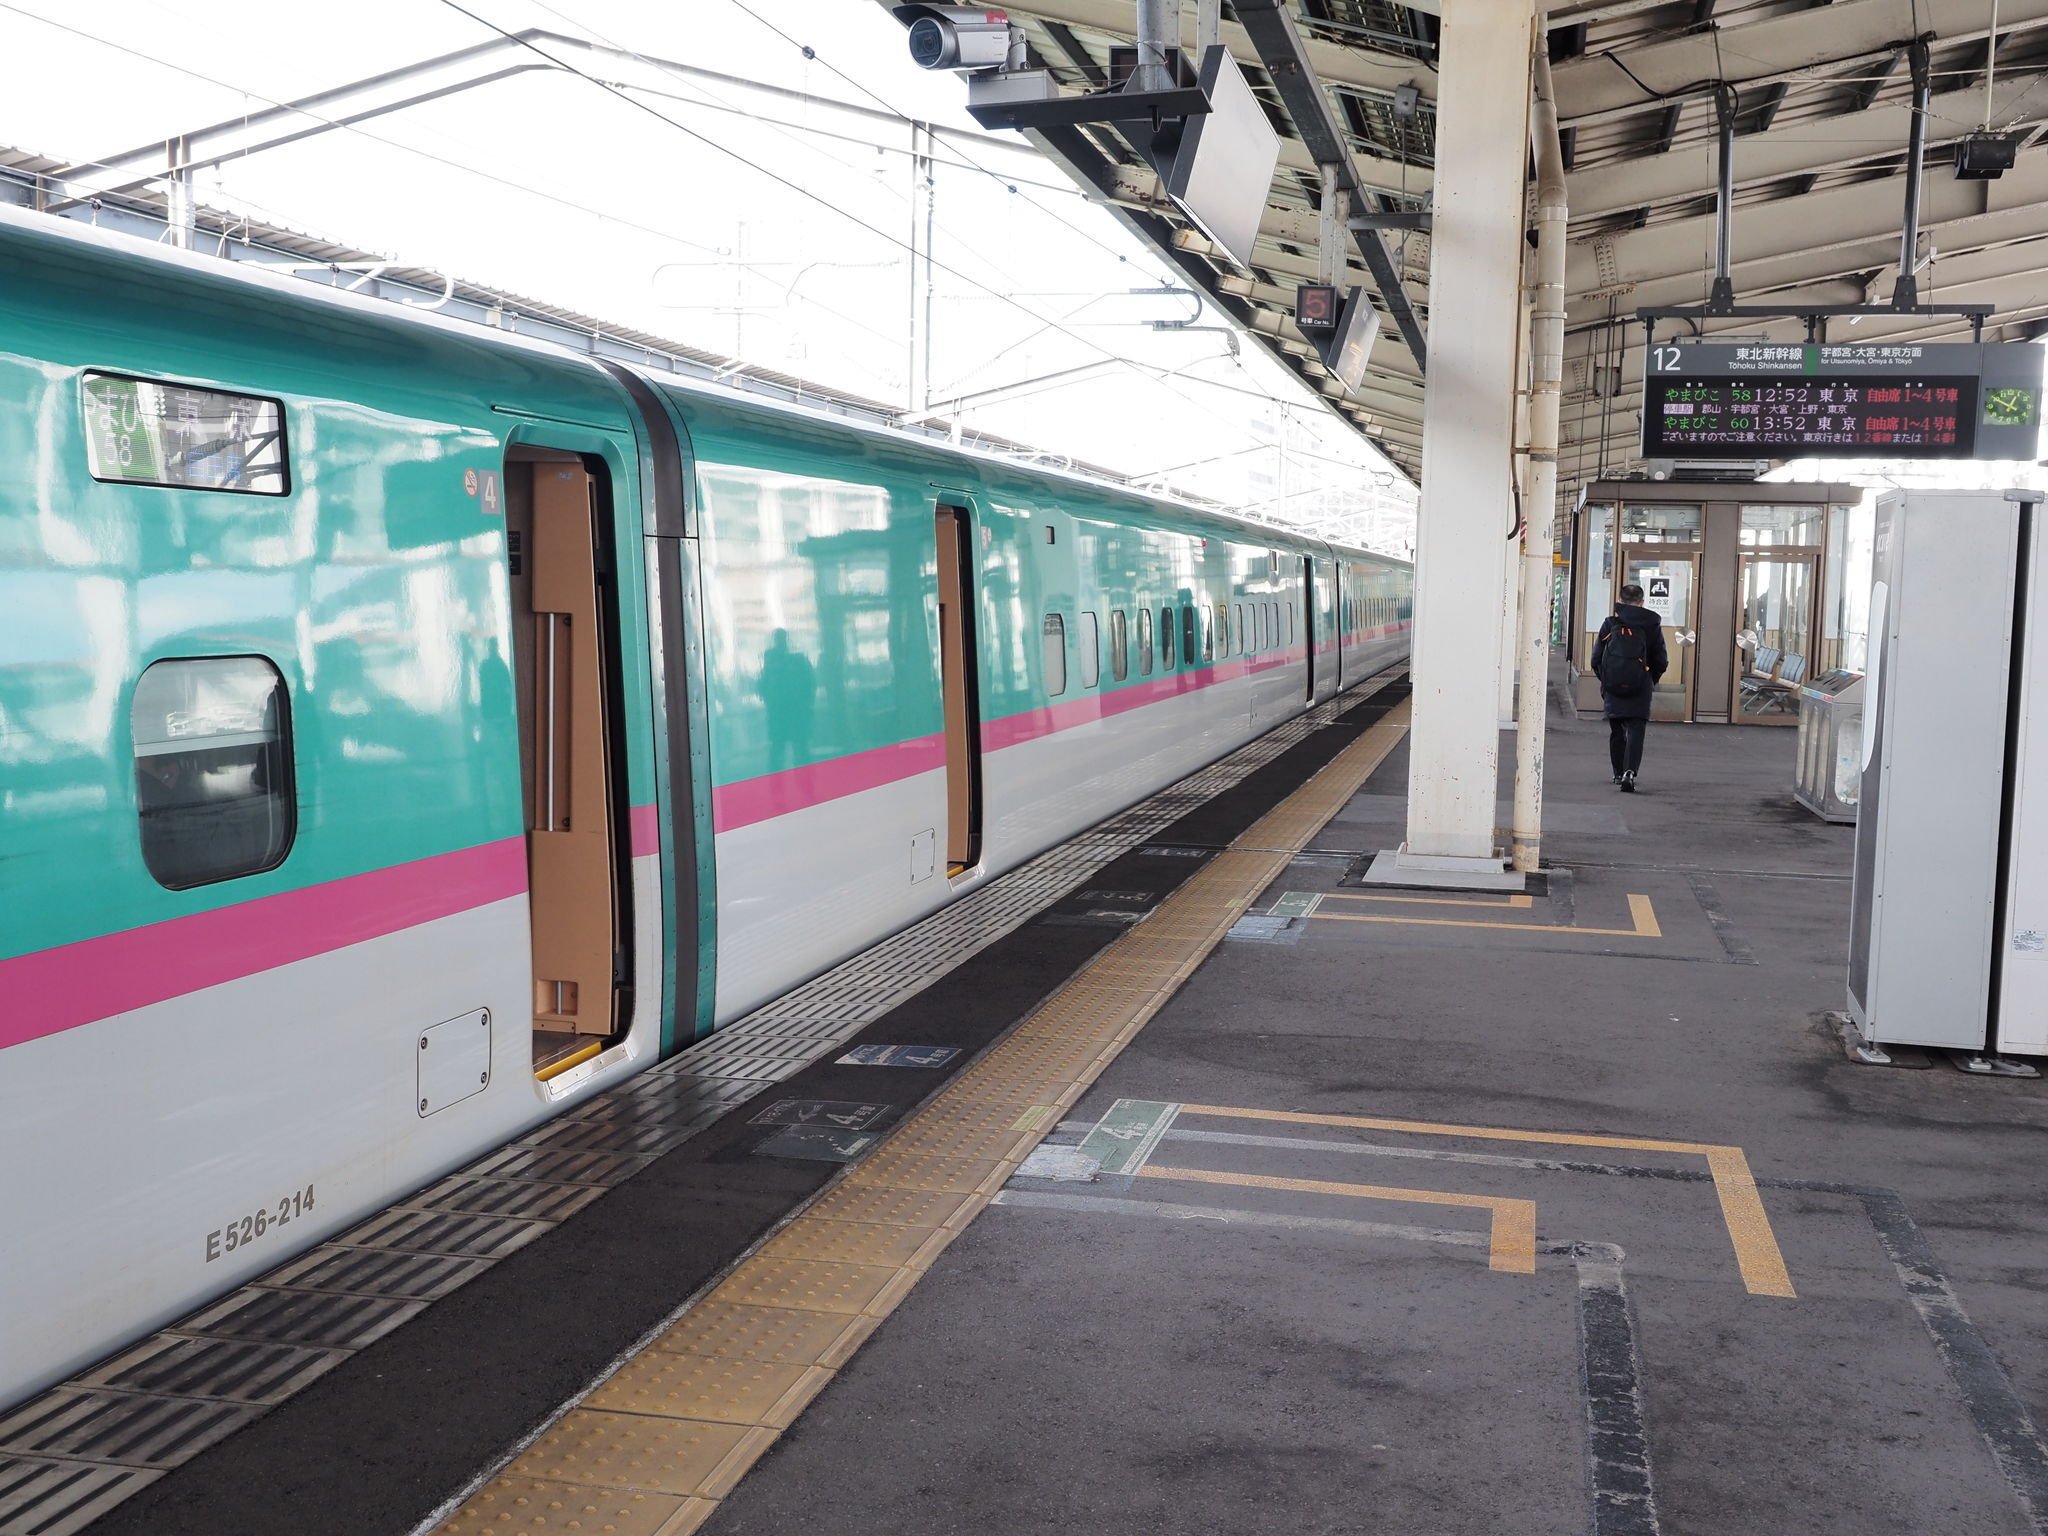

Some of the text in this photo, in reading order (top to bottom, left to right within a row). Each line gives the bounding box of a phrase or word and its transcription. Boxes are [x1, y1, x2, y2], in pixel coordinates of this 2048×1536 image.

[1305, 289, 1331, 318] 5
[1653, 347, 1681, 371] 12
[1736, 347, 1802, 361] 東北新幹線
[1821, 347, 1922, 358] 宇都宮・大宮・東京方面
[1757, 361, 1802, 370] Shinkansen
[1665, 389, 1720, 402] やまびこ
[1732, 389, 1751, 401] 58
[1755, 388, 1808, 402] 12:52
[1664, 416, 1719, 430] やまびこ
[1730, 417, 1749, 429] 60
[1753, 416, 1806, 430] 13:52
[484, 475, 497, 510] 4
[904, 1055, 940, 1065] 4
[825, 1113, 864, 1125] 4
[205, 1183, 316, 1264] E526-214
